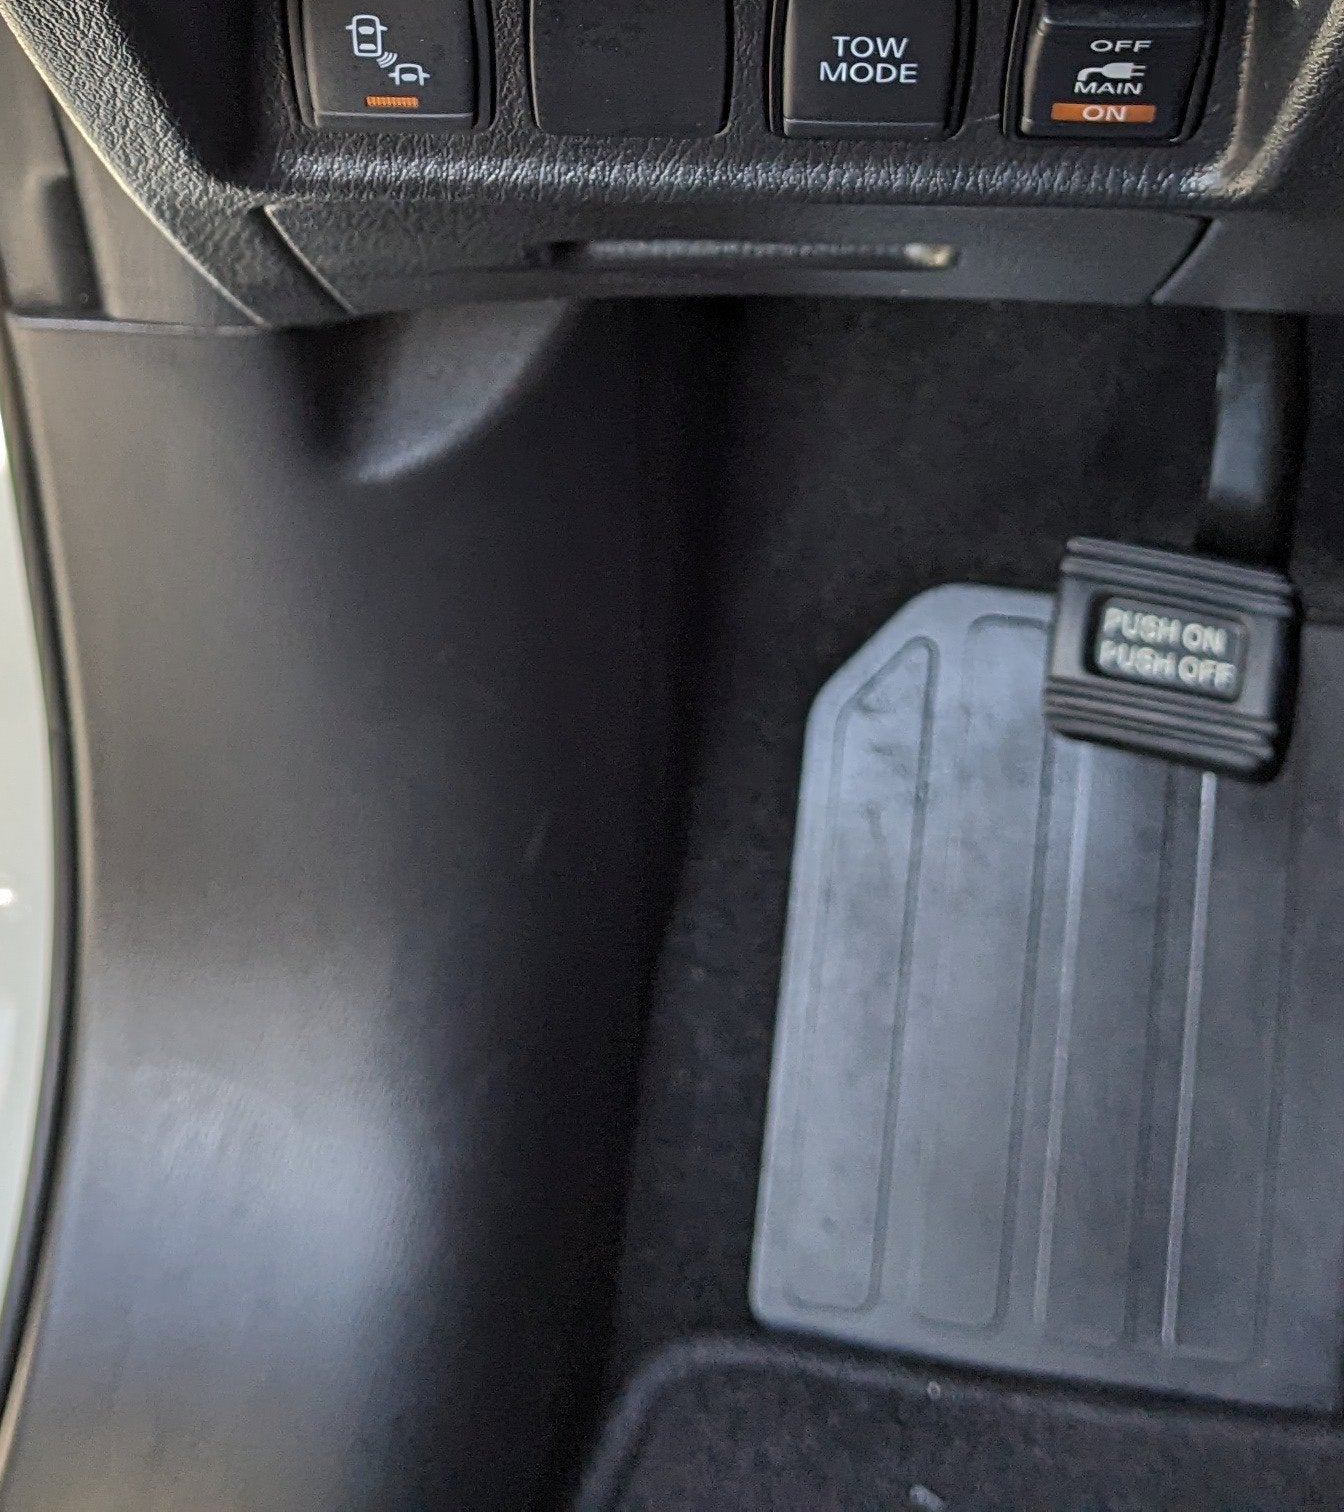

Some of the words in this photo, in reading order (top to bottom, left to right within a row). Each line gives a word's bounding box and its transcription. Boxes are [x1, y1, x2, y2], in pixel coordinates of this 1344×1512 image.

[832, 35, 909, 58] TOW
[1089, 39, 1152, 53] OFF
[819, 60, 918, 84] MODE
[1073, 81, 1144, 96] MAIN
[1081, 104, 1128, 122] ON
[1103, 606, 1181, 646] PUSH
[1182, 622, 1228, 657] ON
[1098, 639, 1177, 680] PUSH
[1177, 655, 1238, 690] OFF
